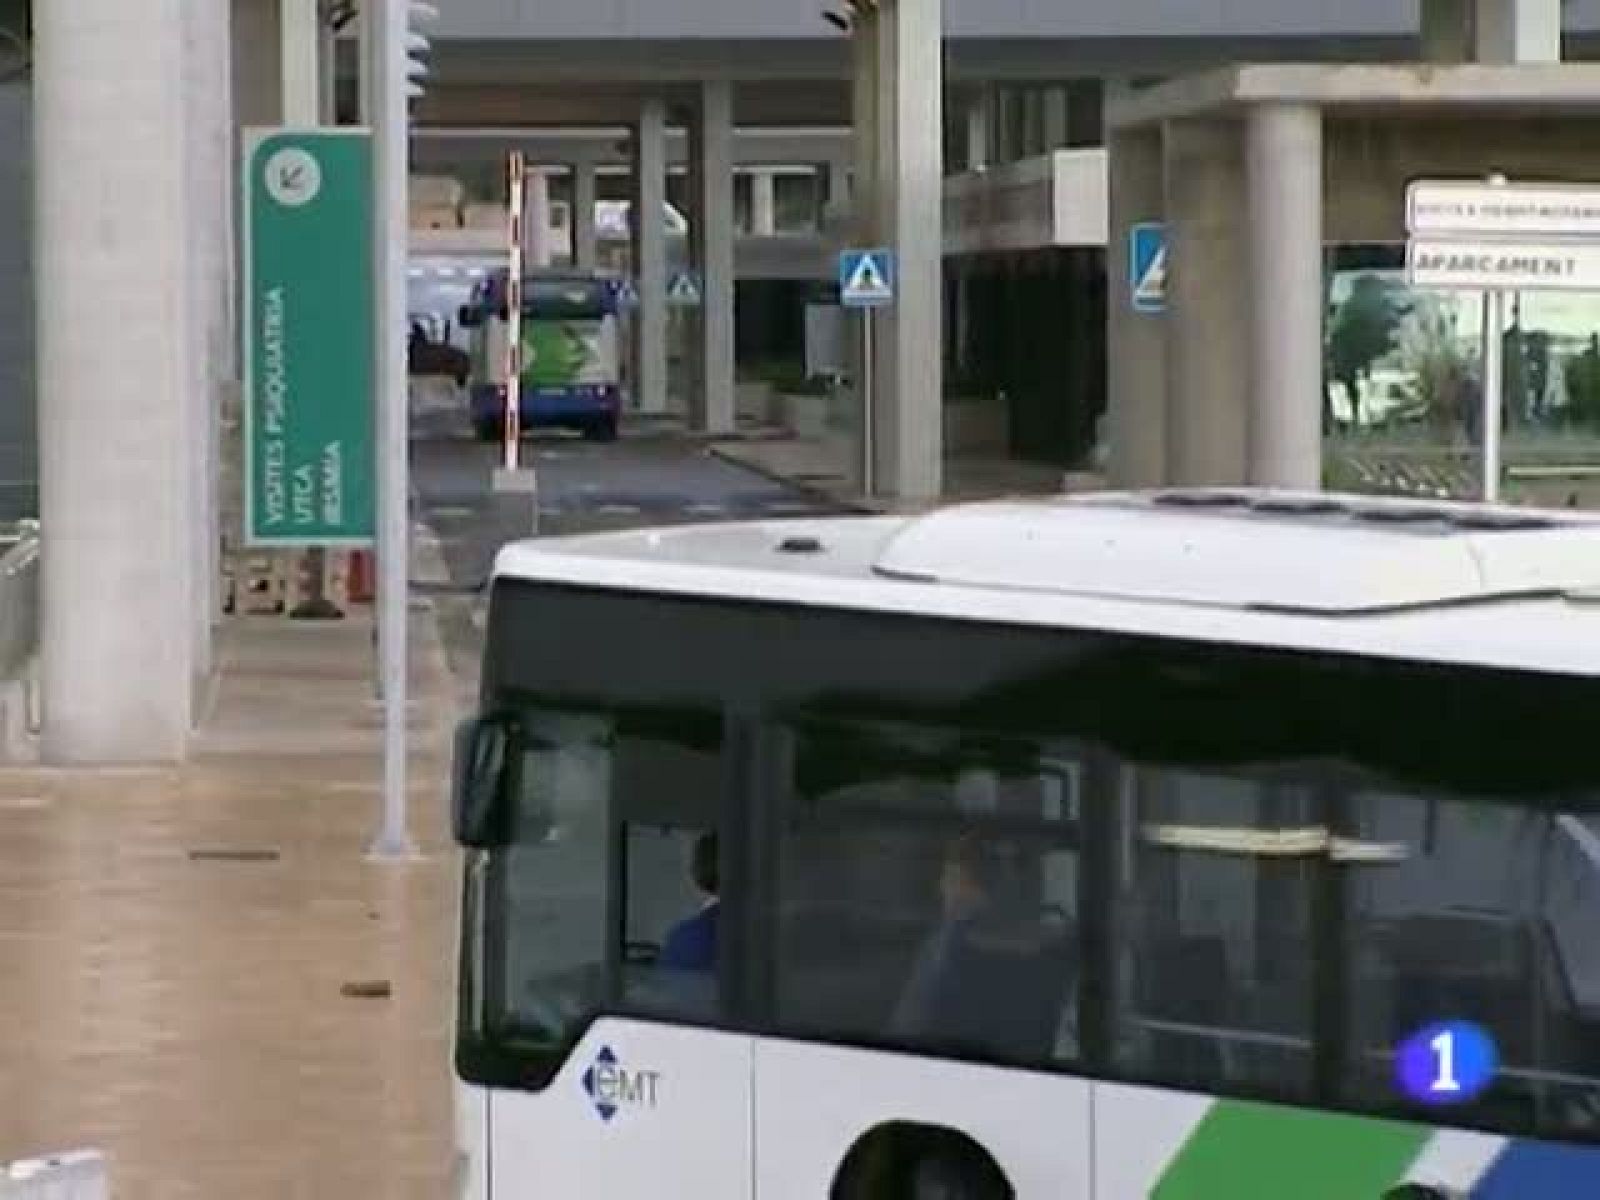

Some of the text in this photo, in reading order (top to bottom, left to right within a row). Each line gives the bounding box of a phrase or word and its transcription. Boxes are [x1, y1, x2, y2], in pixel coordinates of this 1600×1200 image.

[1417, 253, 1575, 276] APARCAMENT
[264, 286, 286, 526] VISITES PSIQUIATRIA
[294, 464, 313, 525] UTCA
